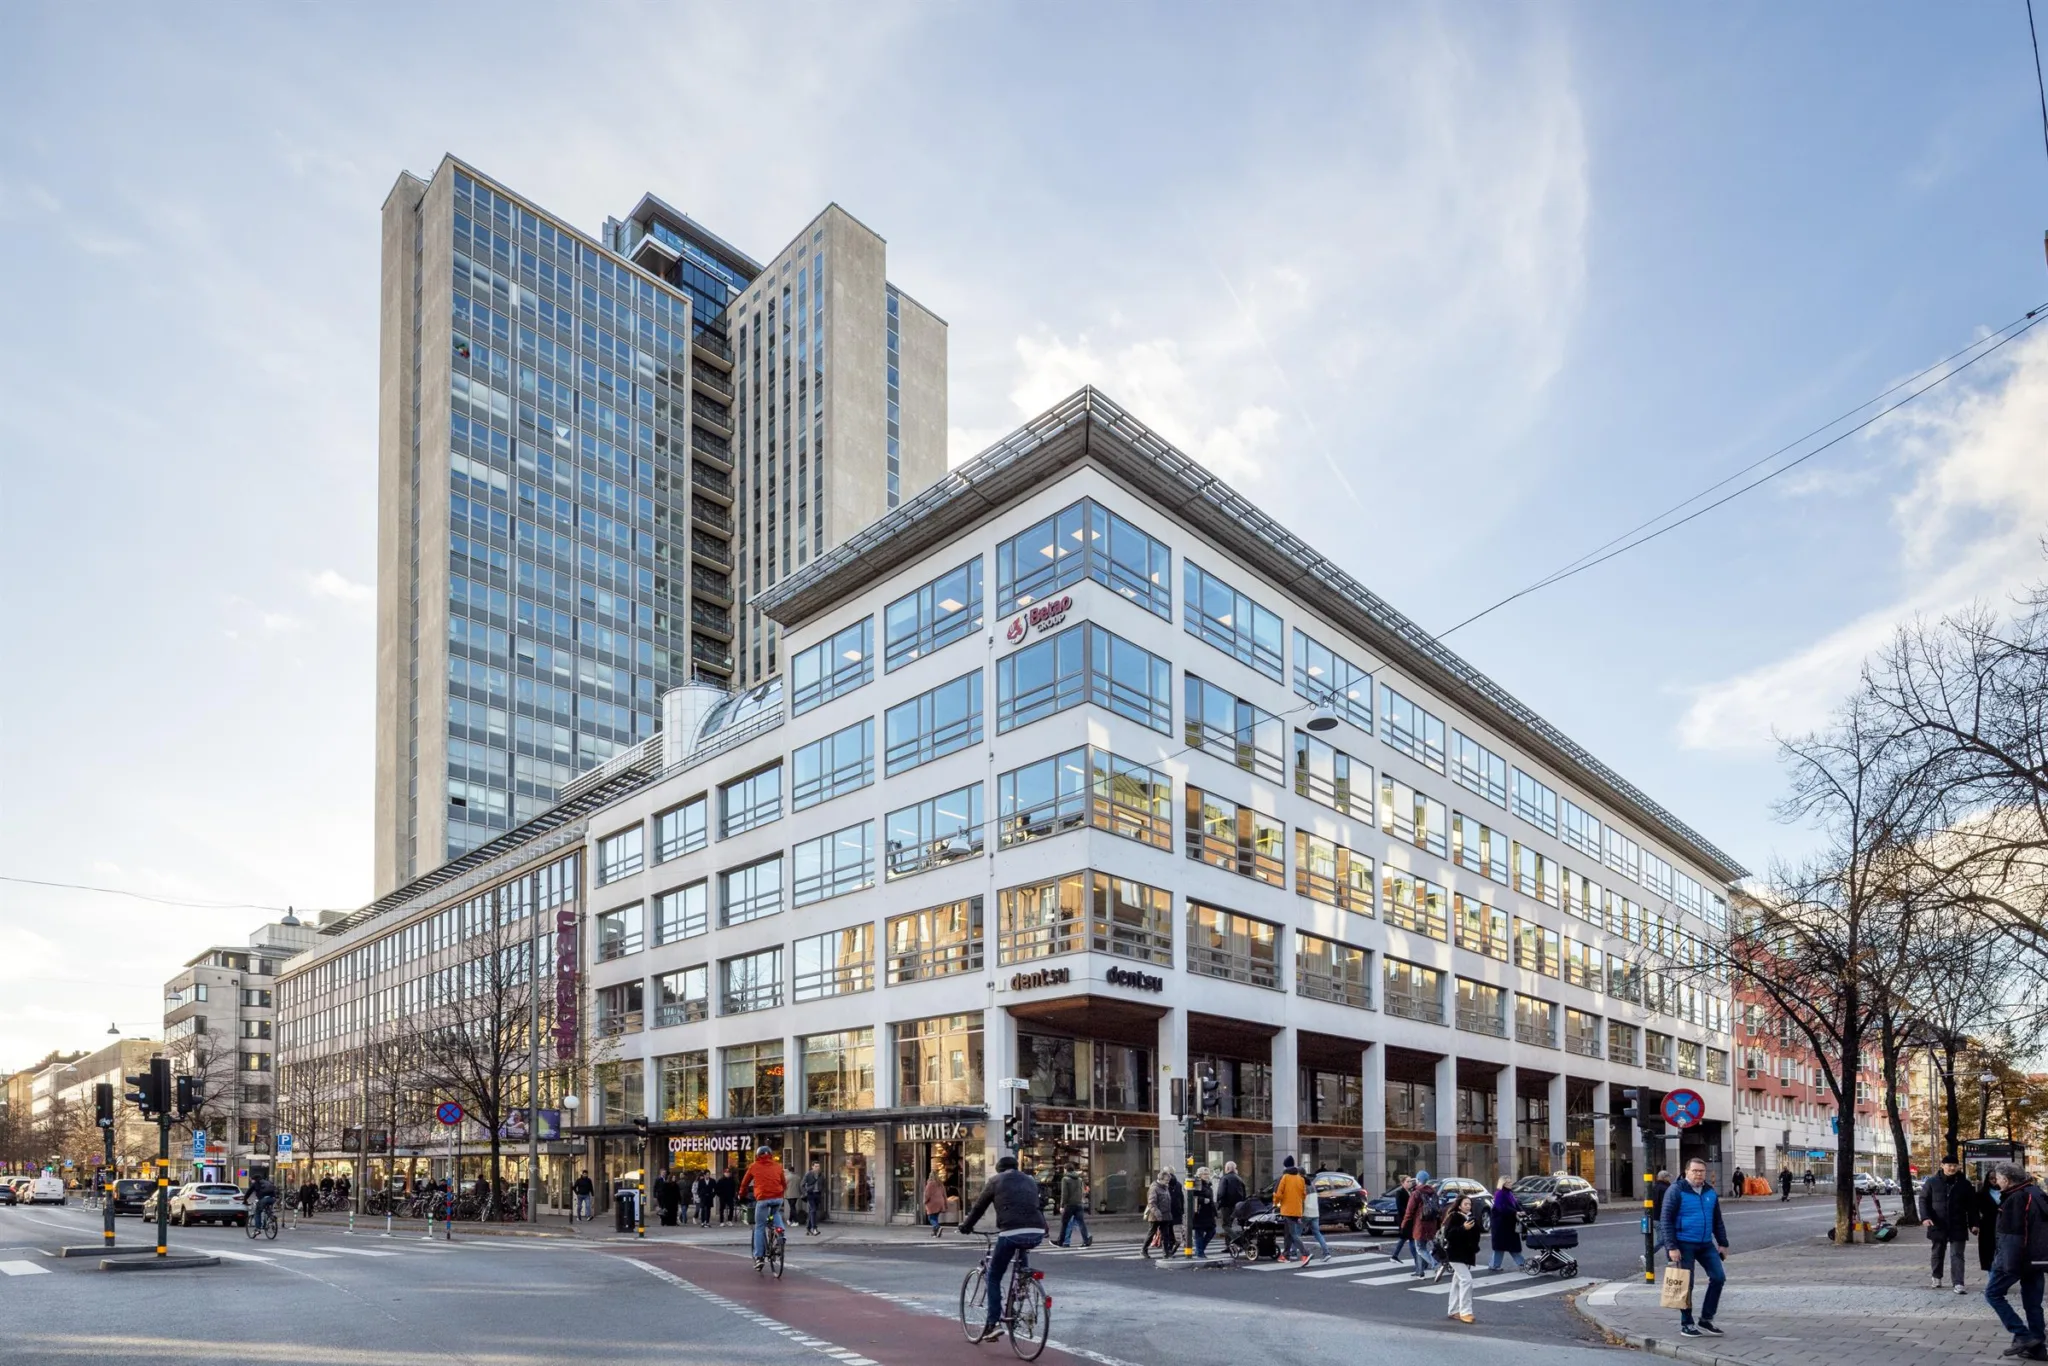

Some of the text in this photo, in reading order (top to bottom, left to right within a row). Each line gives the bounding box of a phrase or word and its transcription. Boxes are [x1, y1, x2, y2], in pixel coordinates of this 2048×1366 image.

[1037, 614, 1065, 632] GROUP
[1011, 967, 1070, 991] dentsu
[1106, 966, 1163, 993] dentsu
[196, 1131, 203, 1139] P
[281, 1135, 290, 1145] P
[902, 1122, 961, 1140] HEMTEX
[1064, 1124, 1126, 1142] HEMTEX
[668, 1135, 751, 1152] COFFEEHOUSE 72
[1666, 1277, 1683, 1286] Igor
